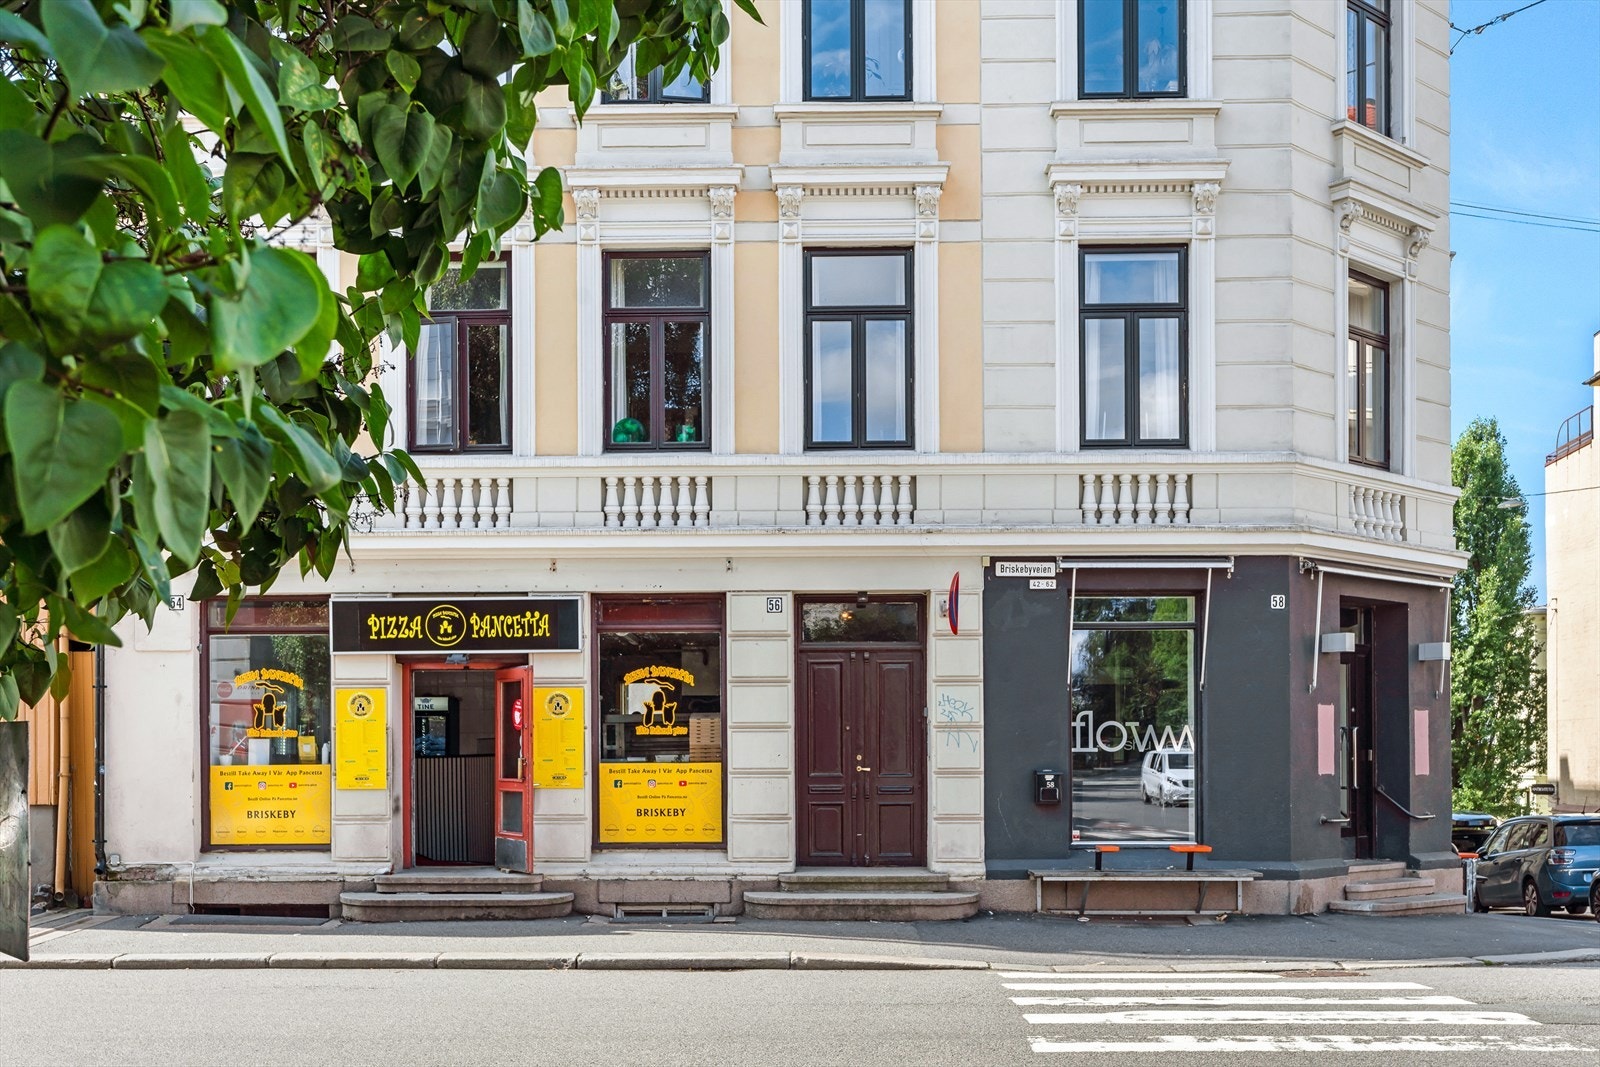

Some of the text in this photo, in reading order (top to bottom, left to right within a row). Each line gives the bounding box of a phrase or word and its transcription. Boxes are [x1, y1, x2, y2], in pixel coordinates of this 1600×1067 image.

[1000, 564, 1052, 575] Briskebyveien
[768, 599, 780, 611] 56
[1272, 596, 1284, 608] 58
[367, 611, 551, 640] PIZZA PANCETTA
[246, 810, 296, 819] BRISKEBY
[636, 808, 686, 817] BRISKEBY
